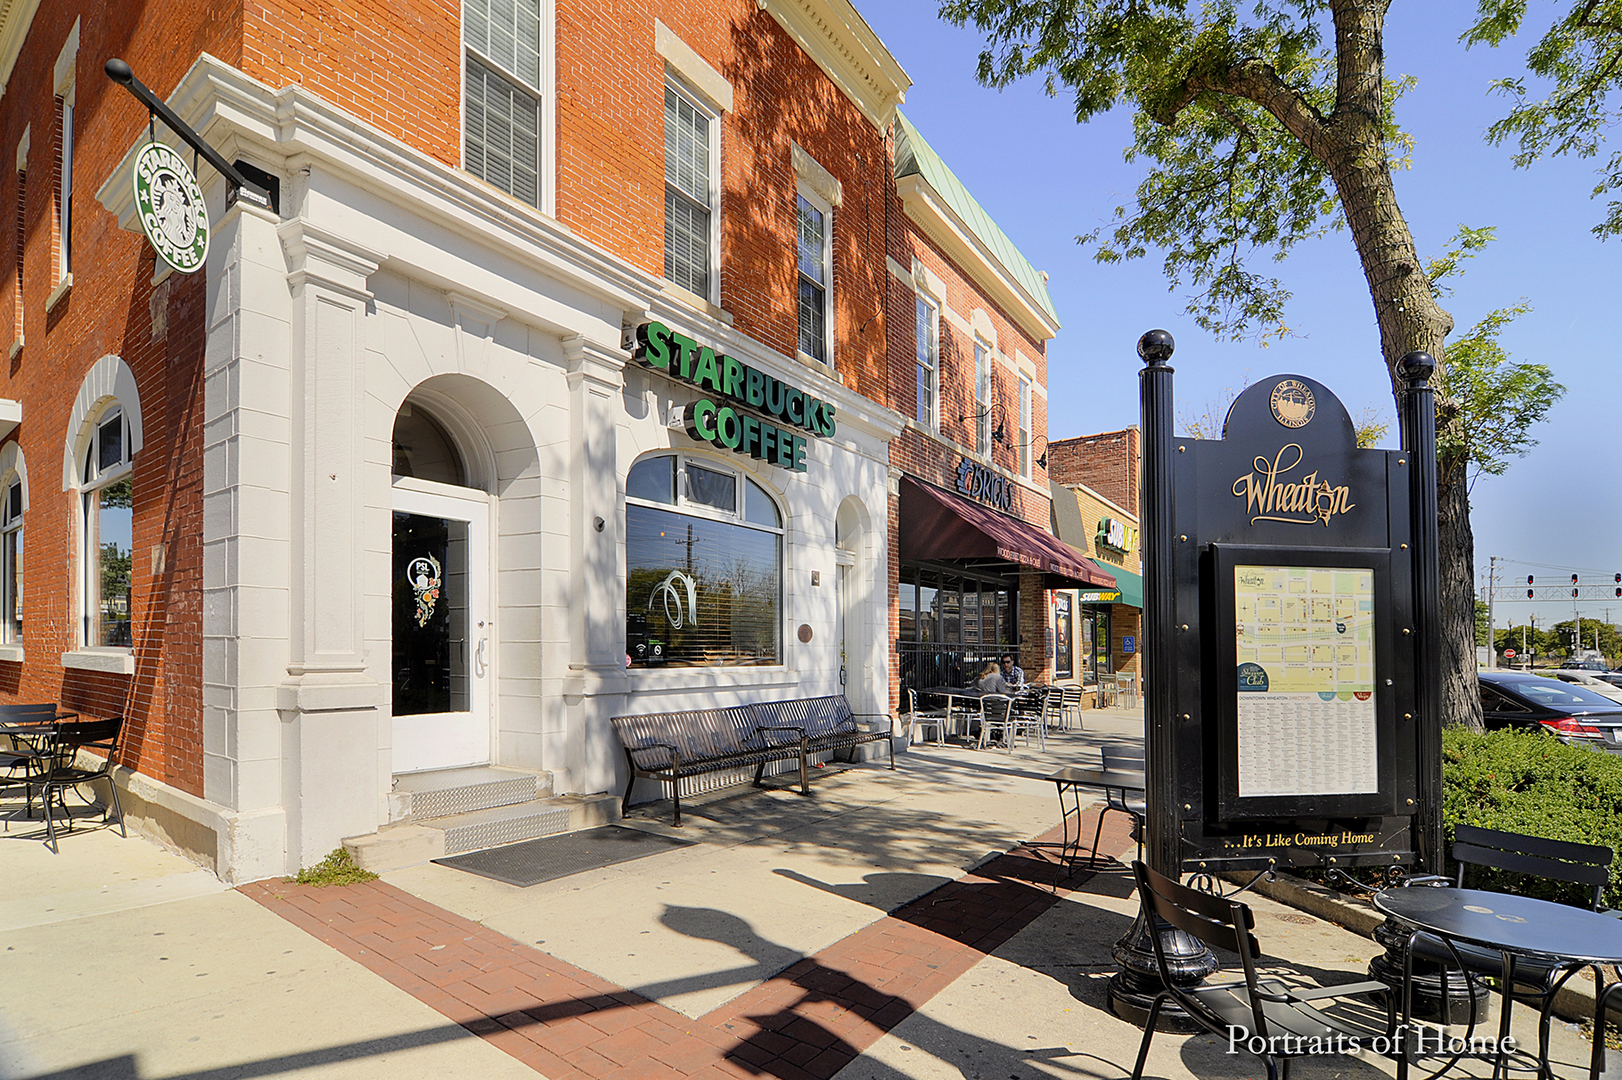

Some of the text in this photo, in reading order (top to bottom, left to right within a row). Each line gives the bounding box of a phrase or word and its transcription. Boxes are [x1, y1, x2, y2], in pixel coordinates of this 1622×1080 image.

[138, 149, 206, 231] STARBUCKS
[145, 212, 199, 267] COFFEE
[645, 321, 836, 438] STARBUCKS
[693, 399, 807, 473] COFFEE
[1277, 414, 1309, 427] ILLINOIS
[971, 464, 1014, 511] BRICKS
[1232, 443, 1356, 527] Wheaton
[1107, 518, 1139, 553] SUBWAY
[416, 562, 430, 571] PSL
[1080, 592, 1120, 601] SUBWAY
[1265, 833, 1292, 847] Like
[1294, 832, 1339, 848] Coming
[1341, 831, 1375, 844] Home
